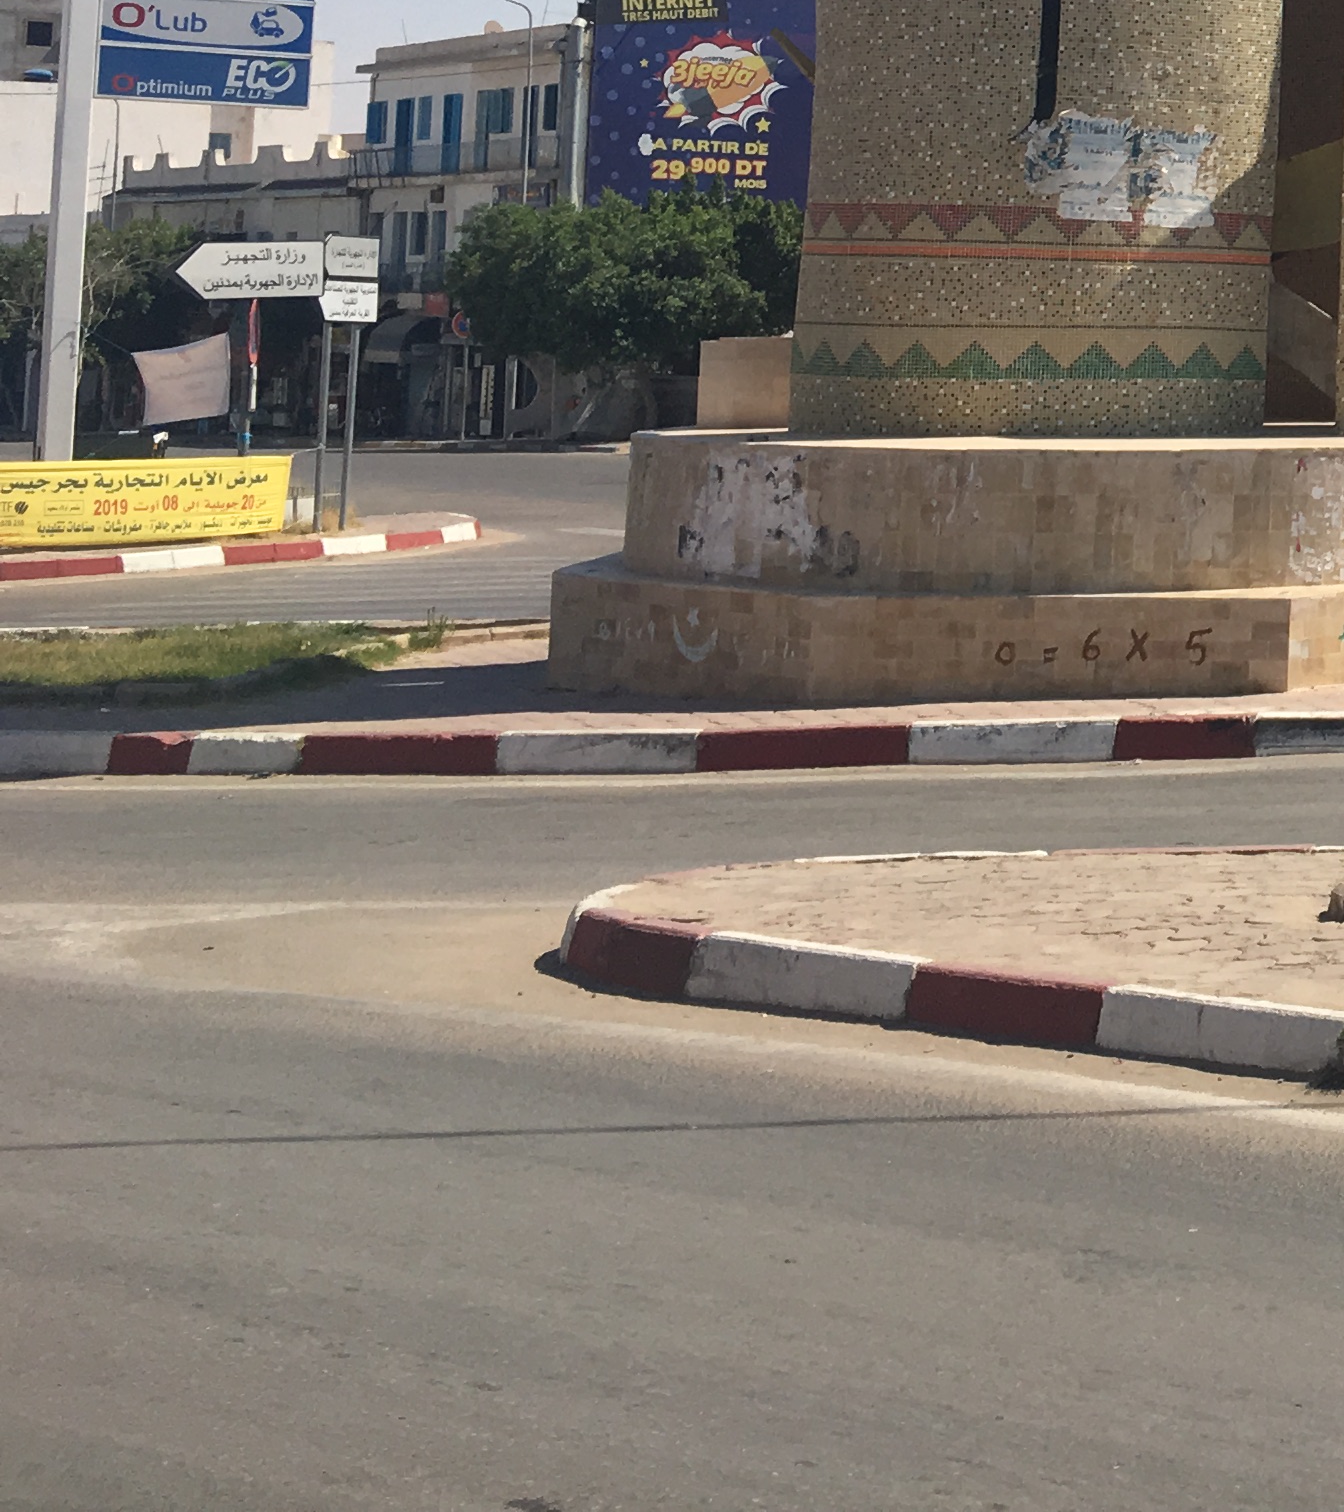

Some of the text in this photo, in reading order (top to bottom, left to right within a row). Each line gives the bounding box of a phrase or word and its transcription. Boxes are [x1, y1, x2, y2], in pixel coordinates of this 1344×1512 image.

[112, 2, 207, 33] O'Lub
[652, 9, 685, 20] HAUT
[225, 58, 296, 93] ECO
[671, 57, 755, 89] 3jeeja
[222, 88, 275, 100] PLUS
[672, 138, 740, 155] PARTIR
[744, 141, 769, 156] DE
[735, 159, 767, 176] DT
[734, 178, 767, 189] MOIS
[221, 248, 306, 266] وزارة التجهيز
[203, 276, 243, 292] بمدنين
[244, 273, 284, 291] الجهوية
[0, 477, 89, 494] بجرجيس
[93, 472, 169, 494] التجارية
[226, 470, 268, 490] معرض
[93, 498, 128, 516] 2019
[162, 495, 179, 511] 08
[204, 498, 239, 512] جويلية
[241, 494, 255, 510] 20
